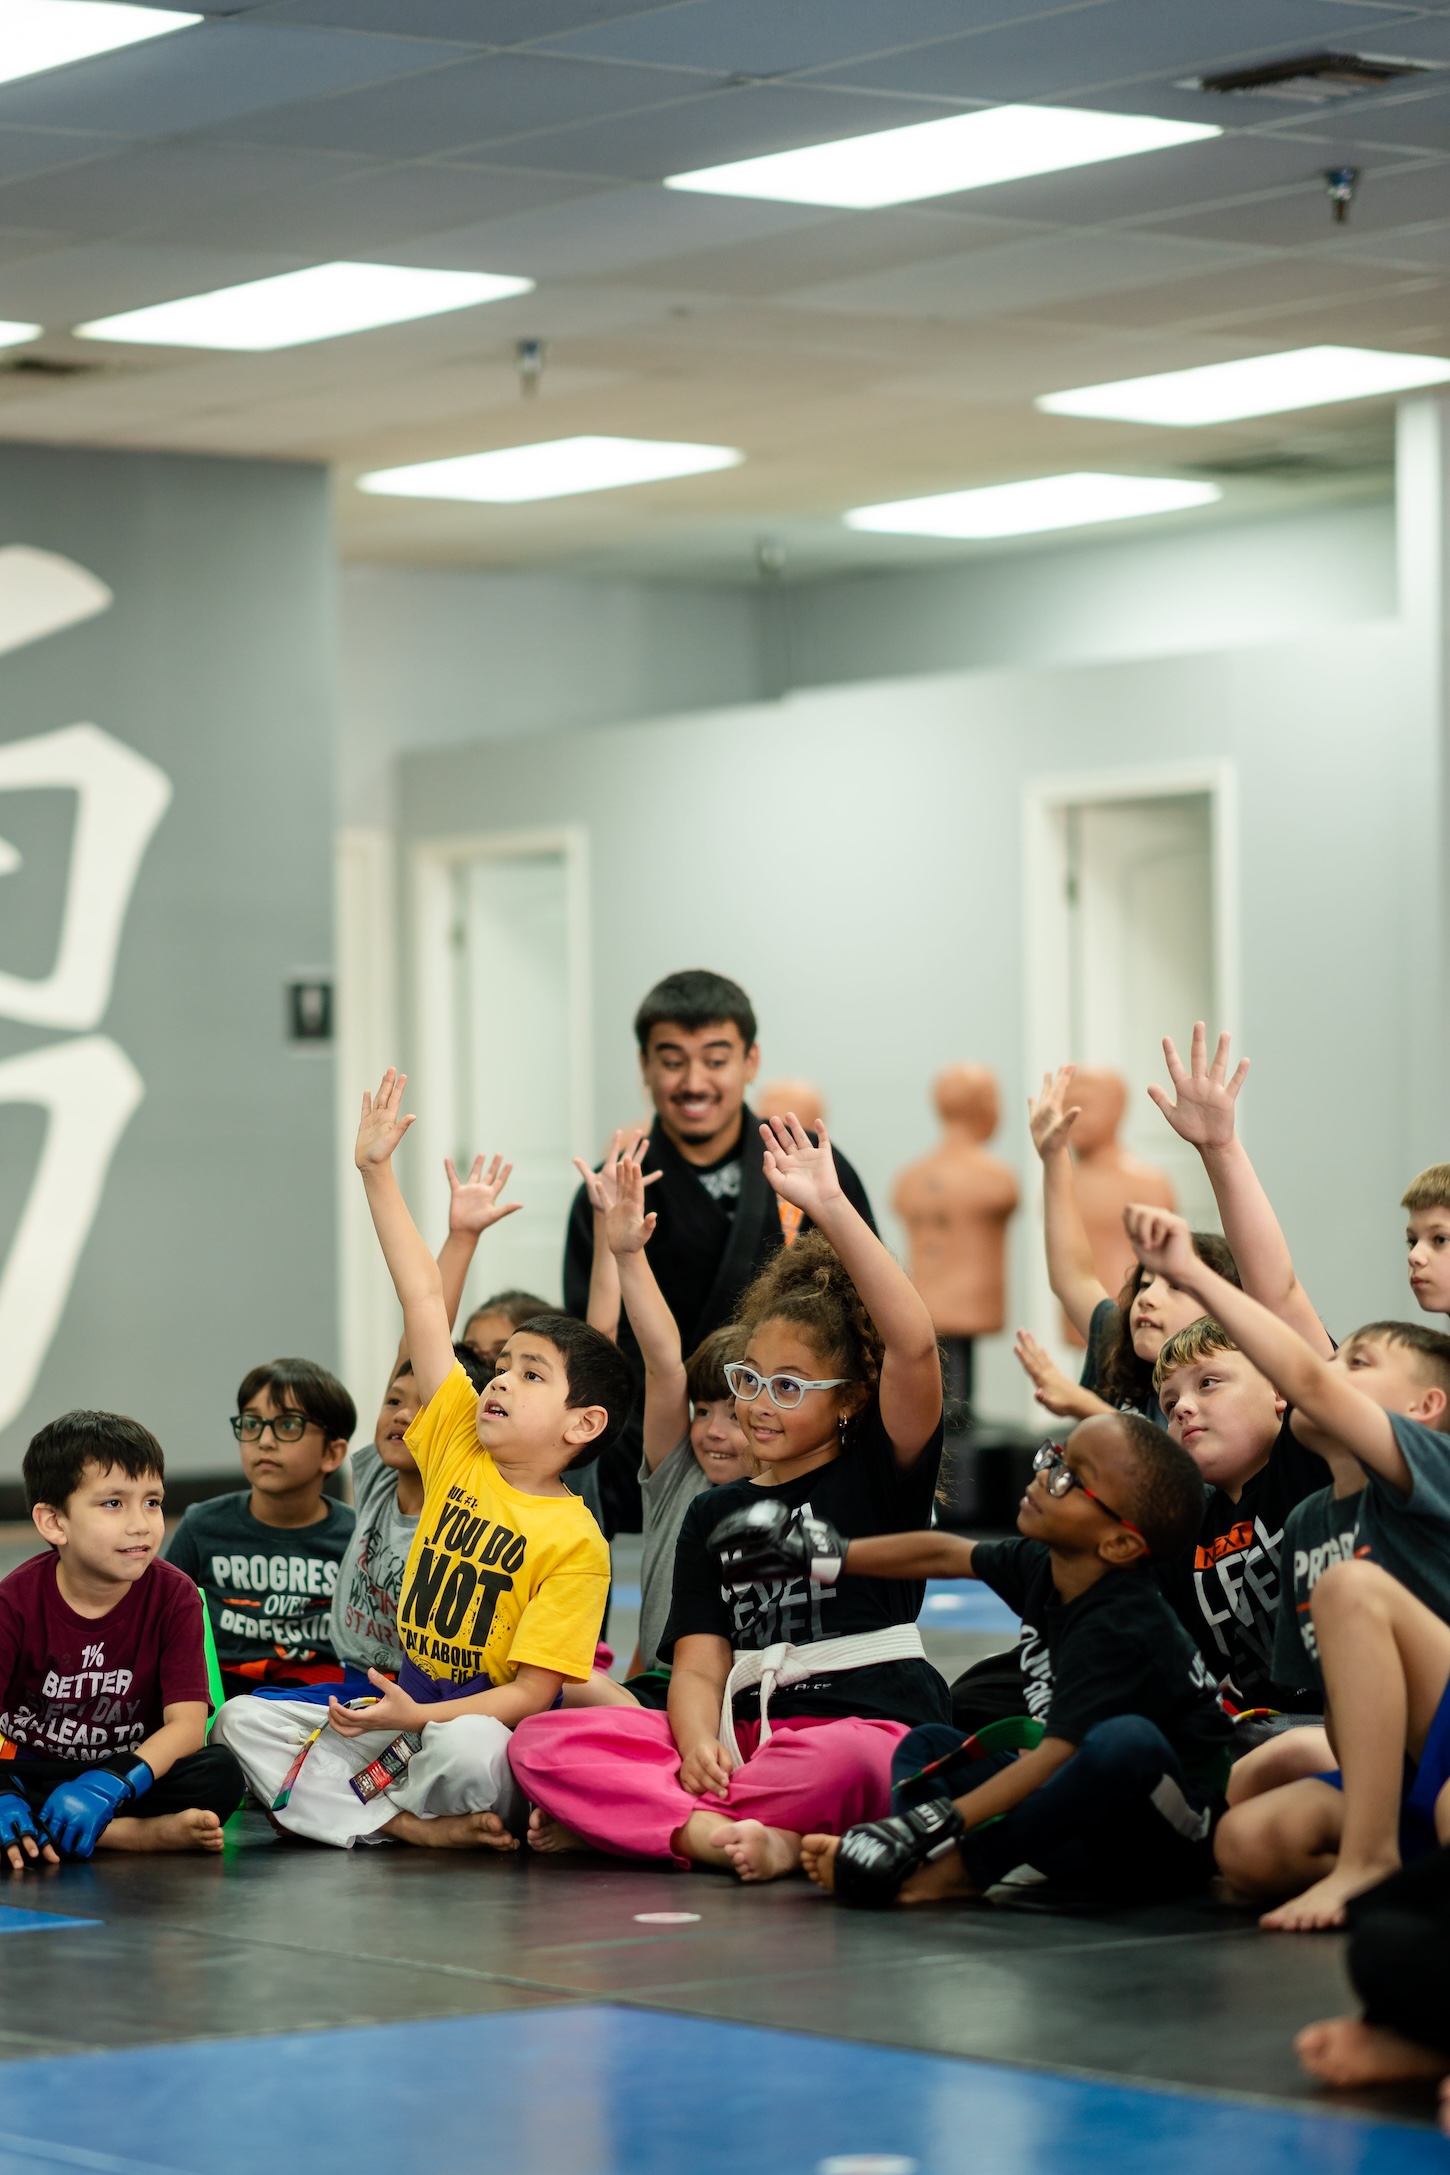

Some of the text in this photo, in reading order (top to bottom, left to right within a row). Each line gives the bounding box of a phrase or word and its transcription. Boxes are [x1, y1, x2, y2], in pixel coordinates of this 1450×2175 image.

[431, 1502, 491, 1558] YOU
[478, 1525, 527, 1575] DO
[1203, 1524, 1247, 1567] NEXT
[211, 1554, 340, 1596] PROGRES
[401, 1547, 514, 1647] NOT
[219, 1608, 332, 1645] PERFECTIO
[81, 1641, 105, 1669] 1%
[430, 1639, 482, 1671] ABOUT
[41, 1668, 134, 1699] BETTER
[25, 1690, 141, 1725] EERY DAY
[46, 1716, 108, 1746] LEAD
[114, 1722, 145, 1744] TO
